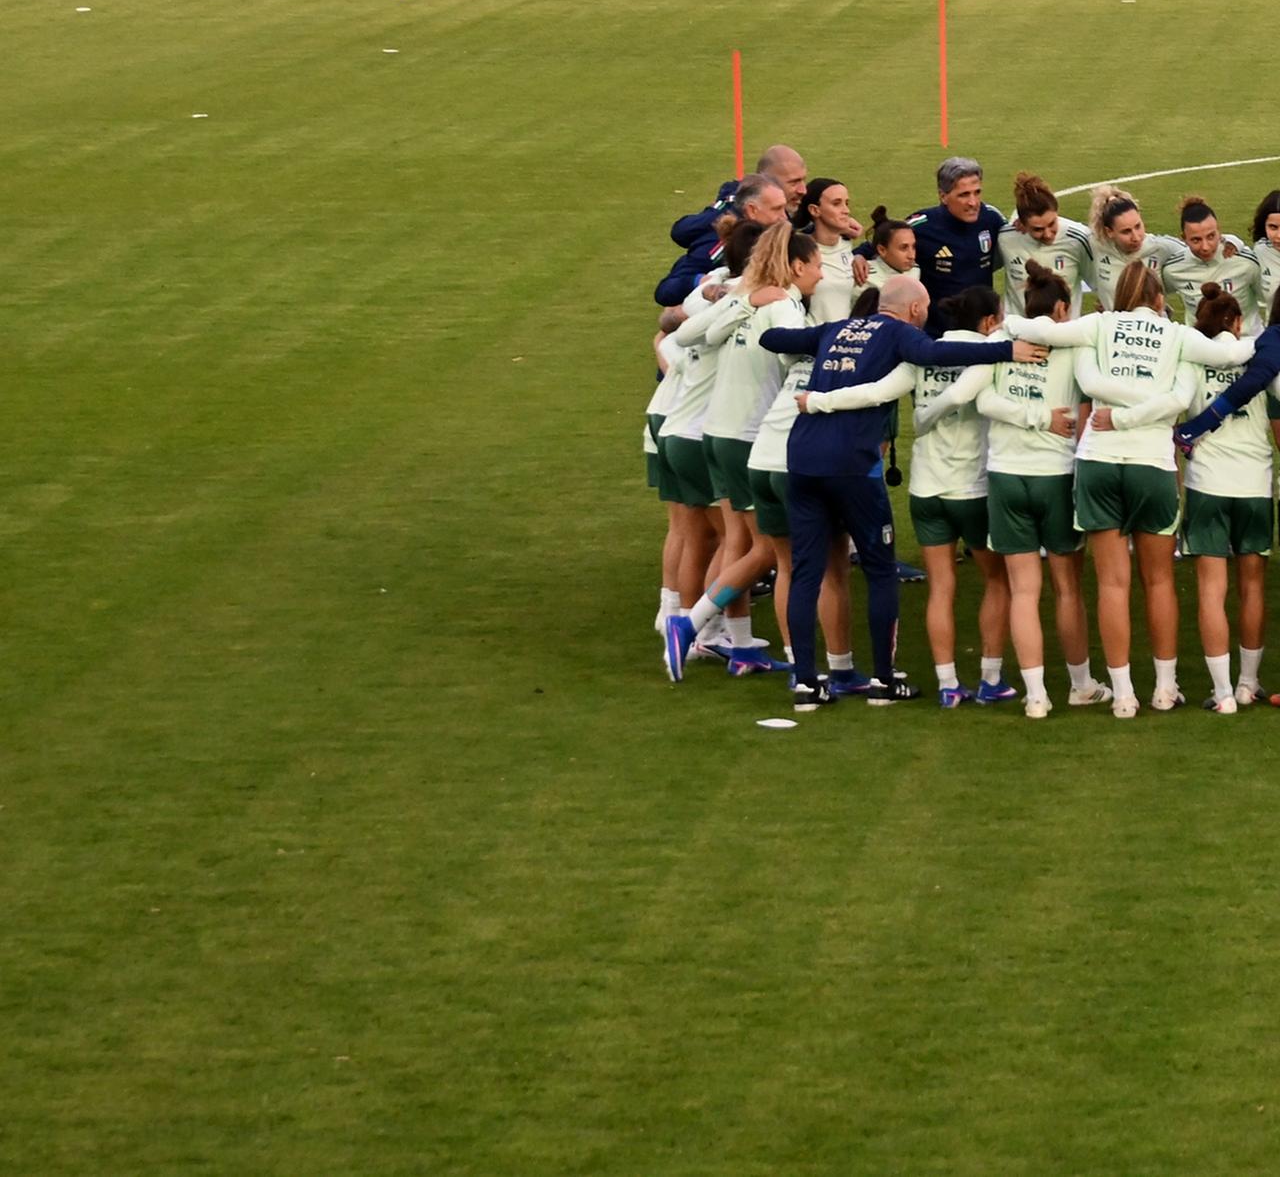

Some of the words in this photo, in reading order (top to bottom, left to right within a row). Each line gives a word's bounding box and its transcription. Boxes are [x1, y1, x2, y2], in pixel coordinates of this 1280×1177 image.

[1135, 320, 1164, 335] TIM
[1113, 330, 1162, 350] Poste
[822, 359, 842, 372] en
[1110, 363, 1136, 377] eni
[923, 366, 961, 383] Post
[1205, 369, 1241, 384] Post
[1008, 384, 1030, 400] eni
